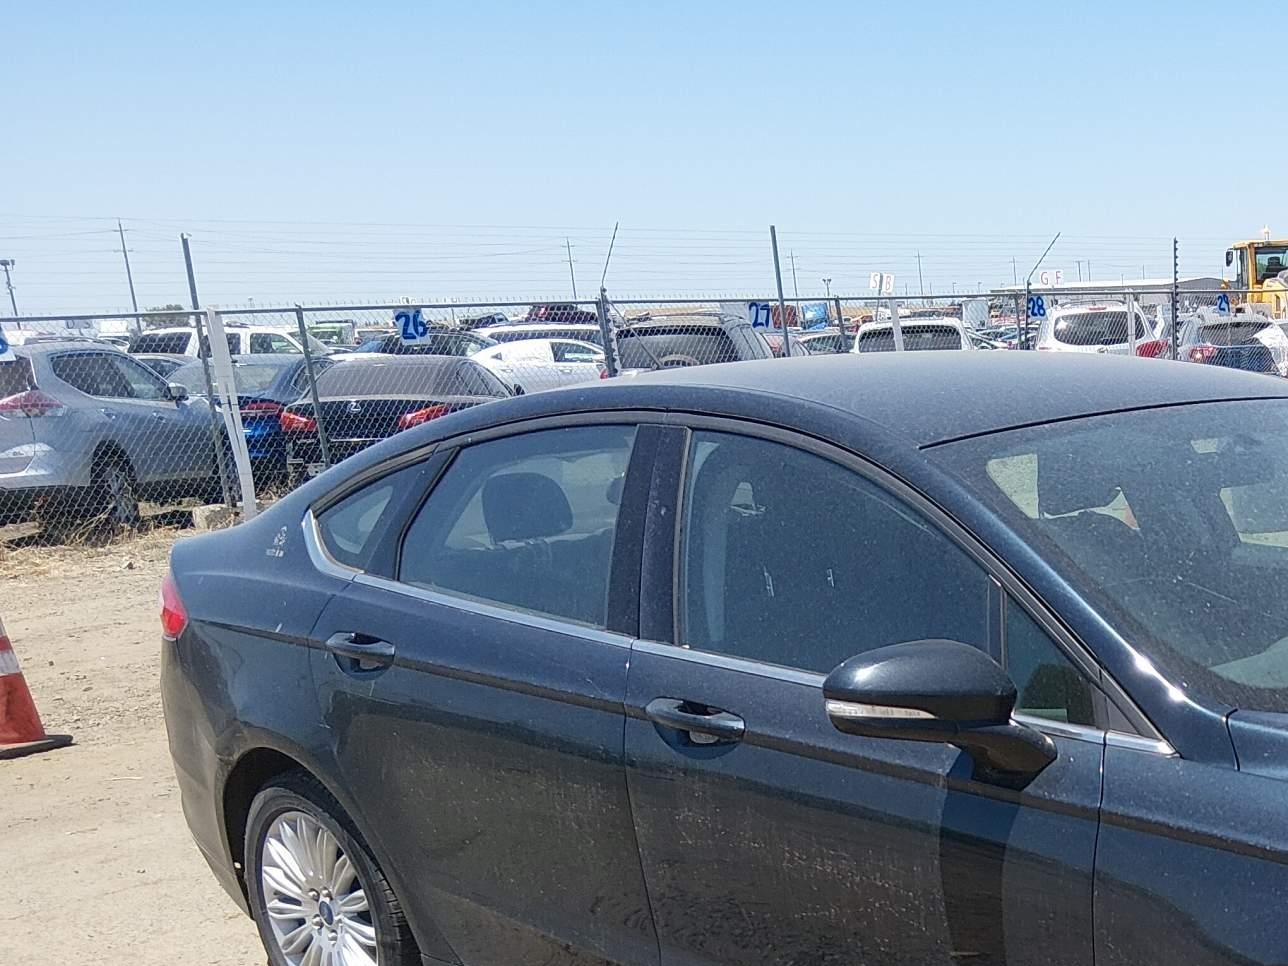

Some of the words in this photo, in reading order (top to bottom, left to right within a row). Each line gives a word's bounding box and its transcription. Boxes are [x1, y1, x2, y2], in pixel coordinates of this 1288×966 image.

[1041, 271, 1049, 286] G
[1055, 271, 1062, 285] F
[1028, 296, 1046, 317] 28
[1217, 294, 1230, 312] 29
[395, 310, 429, 340] 26
[748, 302, 771, 328] 27
